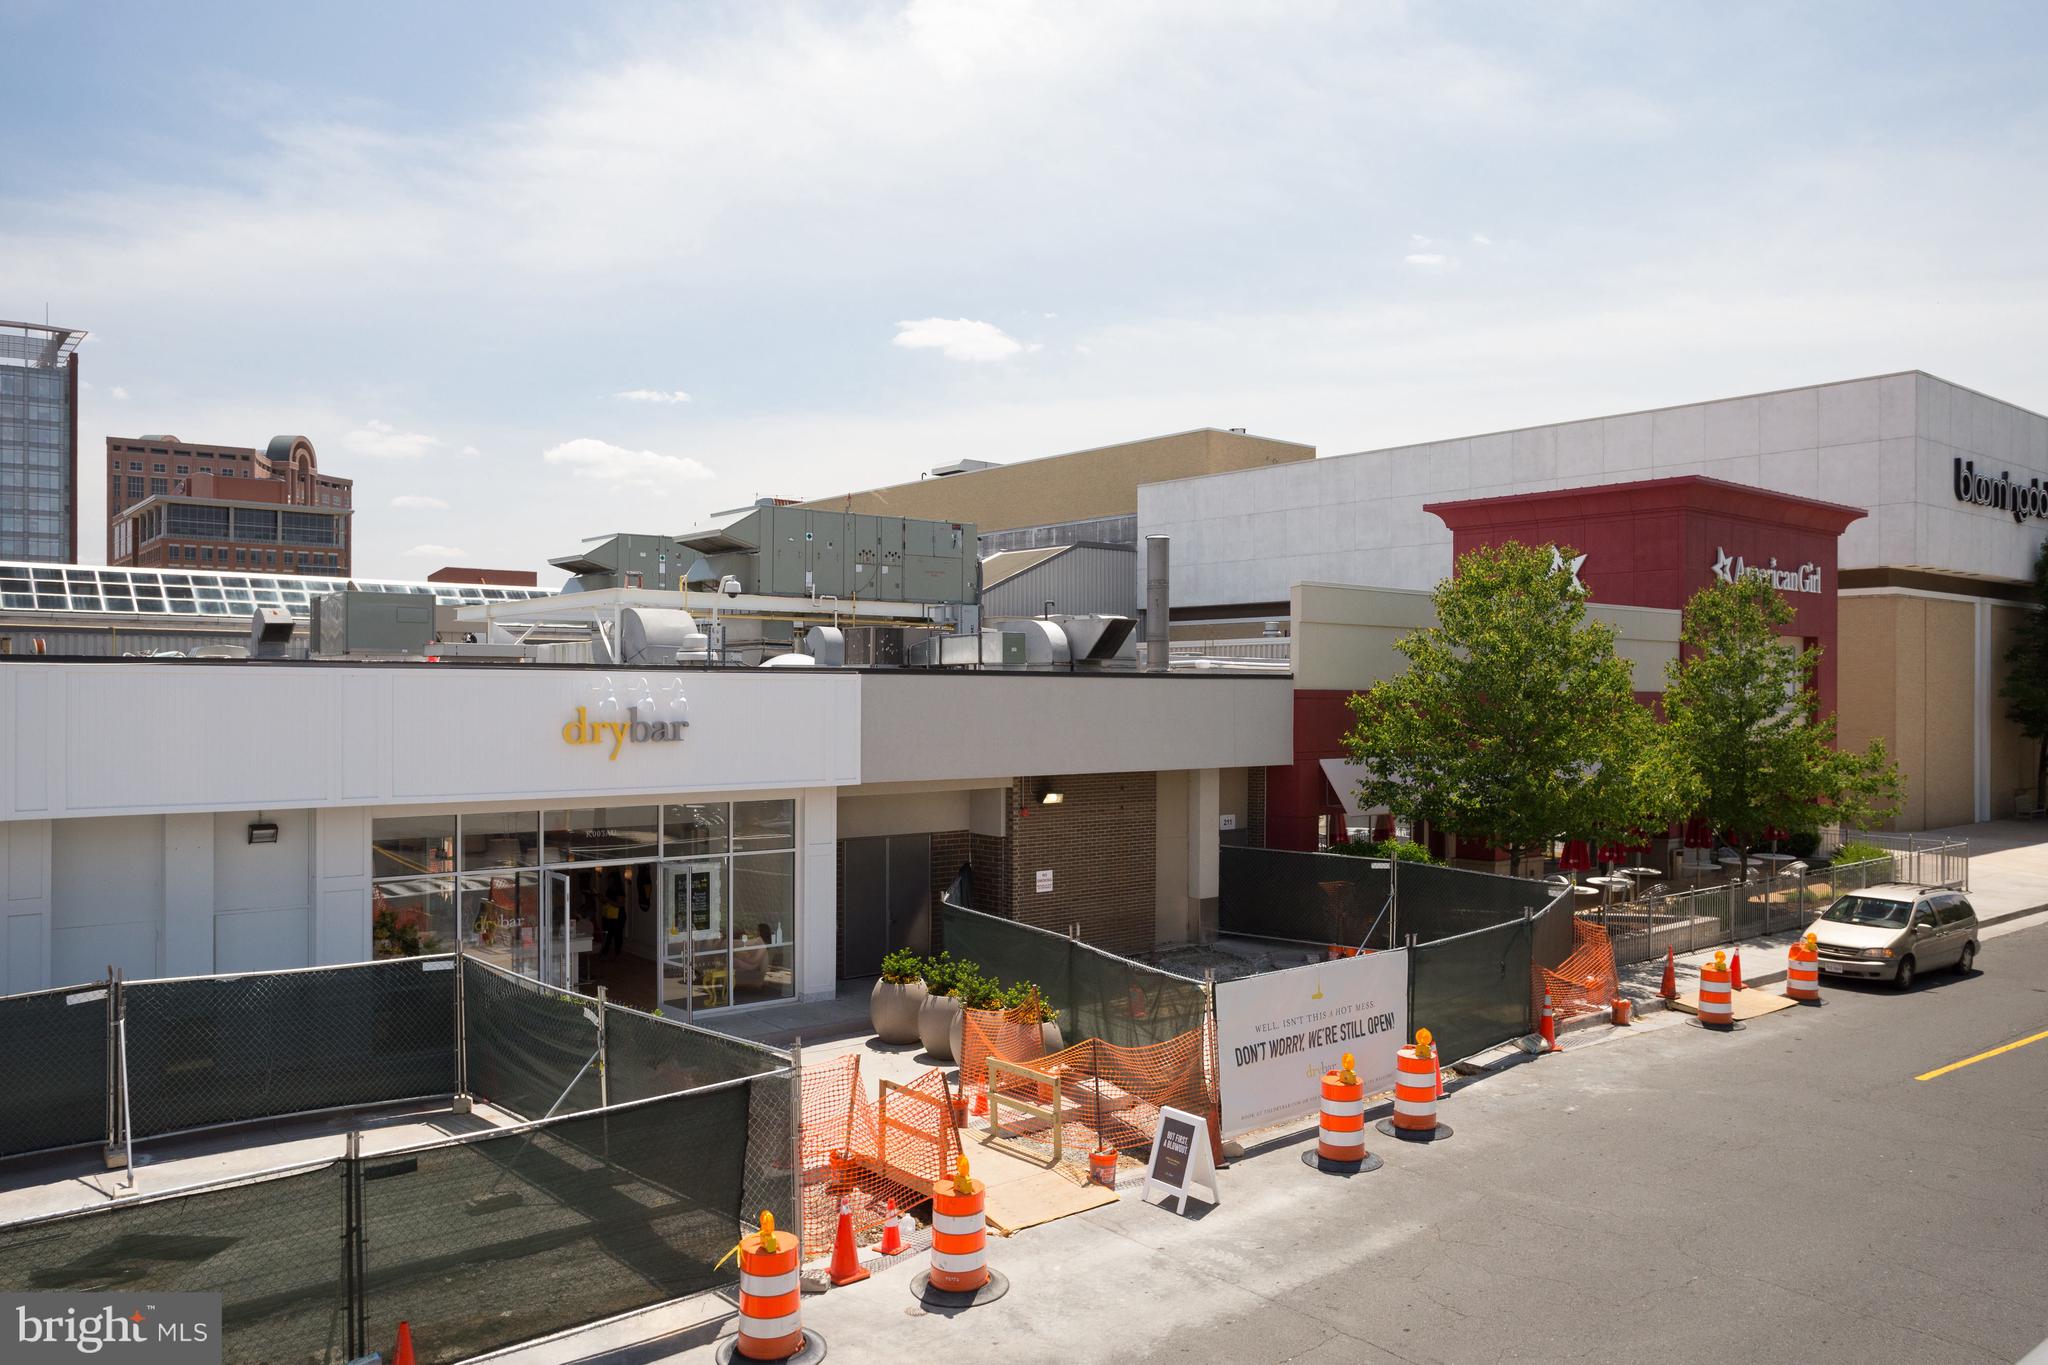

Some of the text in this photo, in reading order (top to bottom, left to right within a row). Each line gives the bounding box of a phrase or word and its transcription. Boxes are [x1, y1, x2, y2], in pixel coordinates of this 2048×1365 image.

[562, 706, 689, 760] drybar
[1235, 1042, 1266, 1067] DON'T
[1308, 1025, 1338, 1049] WE'RE
[1340, 1019, 1366, 1041] STILL
[1367, 1011, 1395, 1035] OPEN!
[1306, 1011, 1327, 1022] THIS
[1335, 1005, 1352, 1016] HOT
